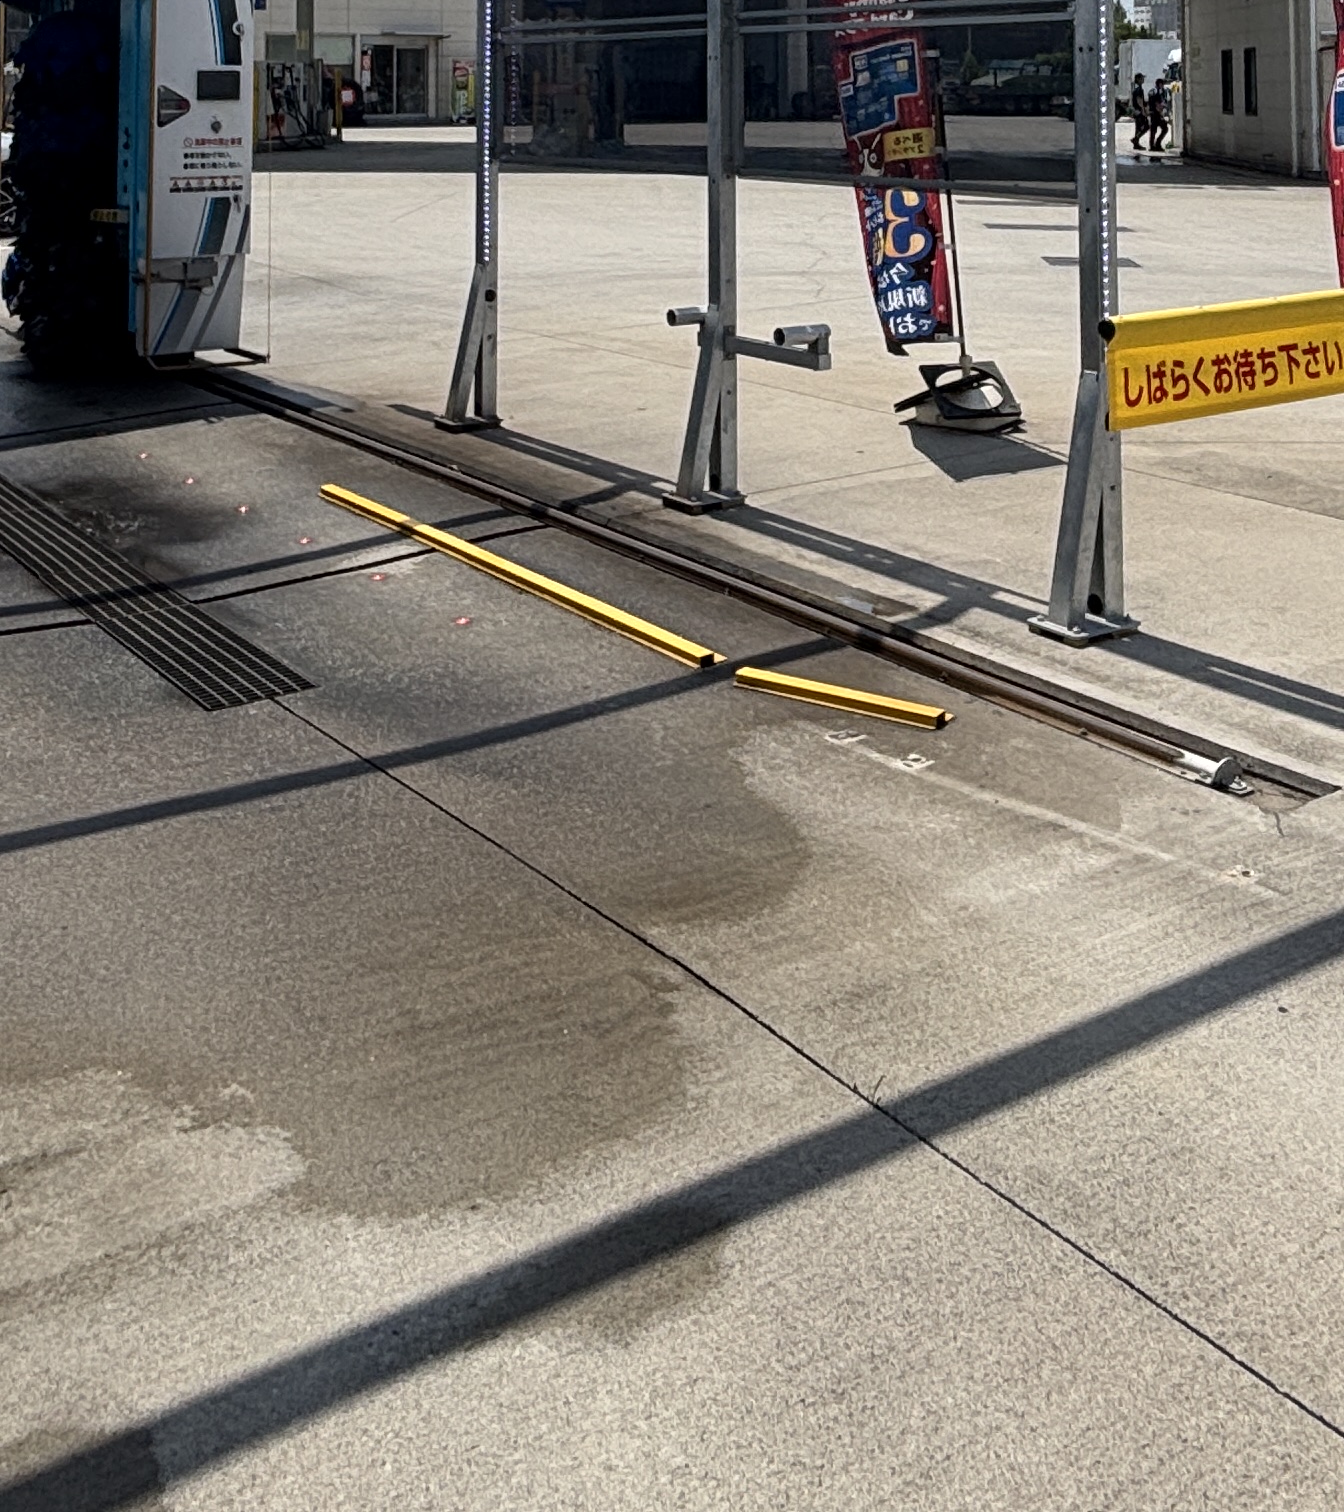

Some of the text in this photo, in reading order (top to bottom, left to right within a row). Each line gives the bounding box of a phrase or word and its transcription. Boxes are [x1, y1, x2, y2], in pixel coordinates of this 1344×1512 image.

[1122, 339, 1344, 408] しばらくお待ち下さい
